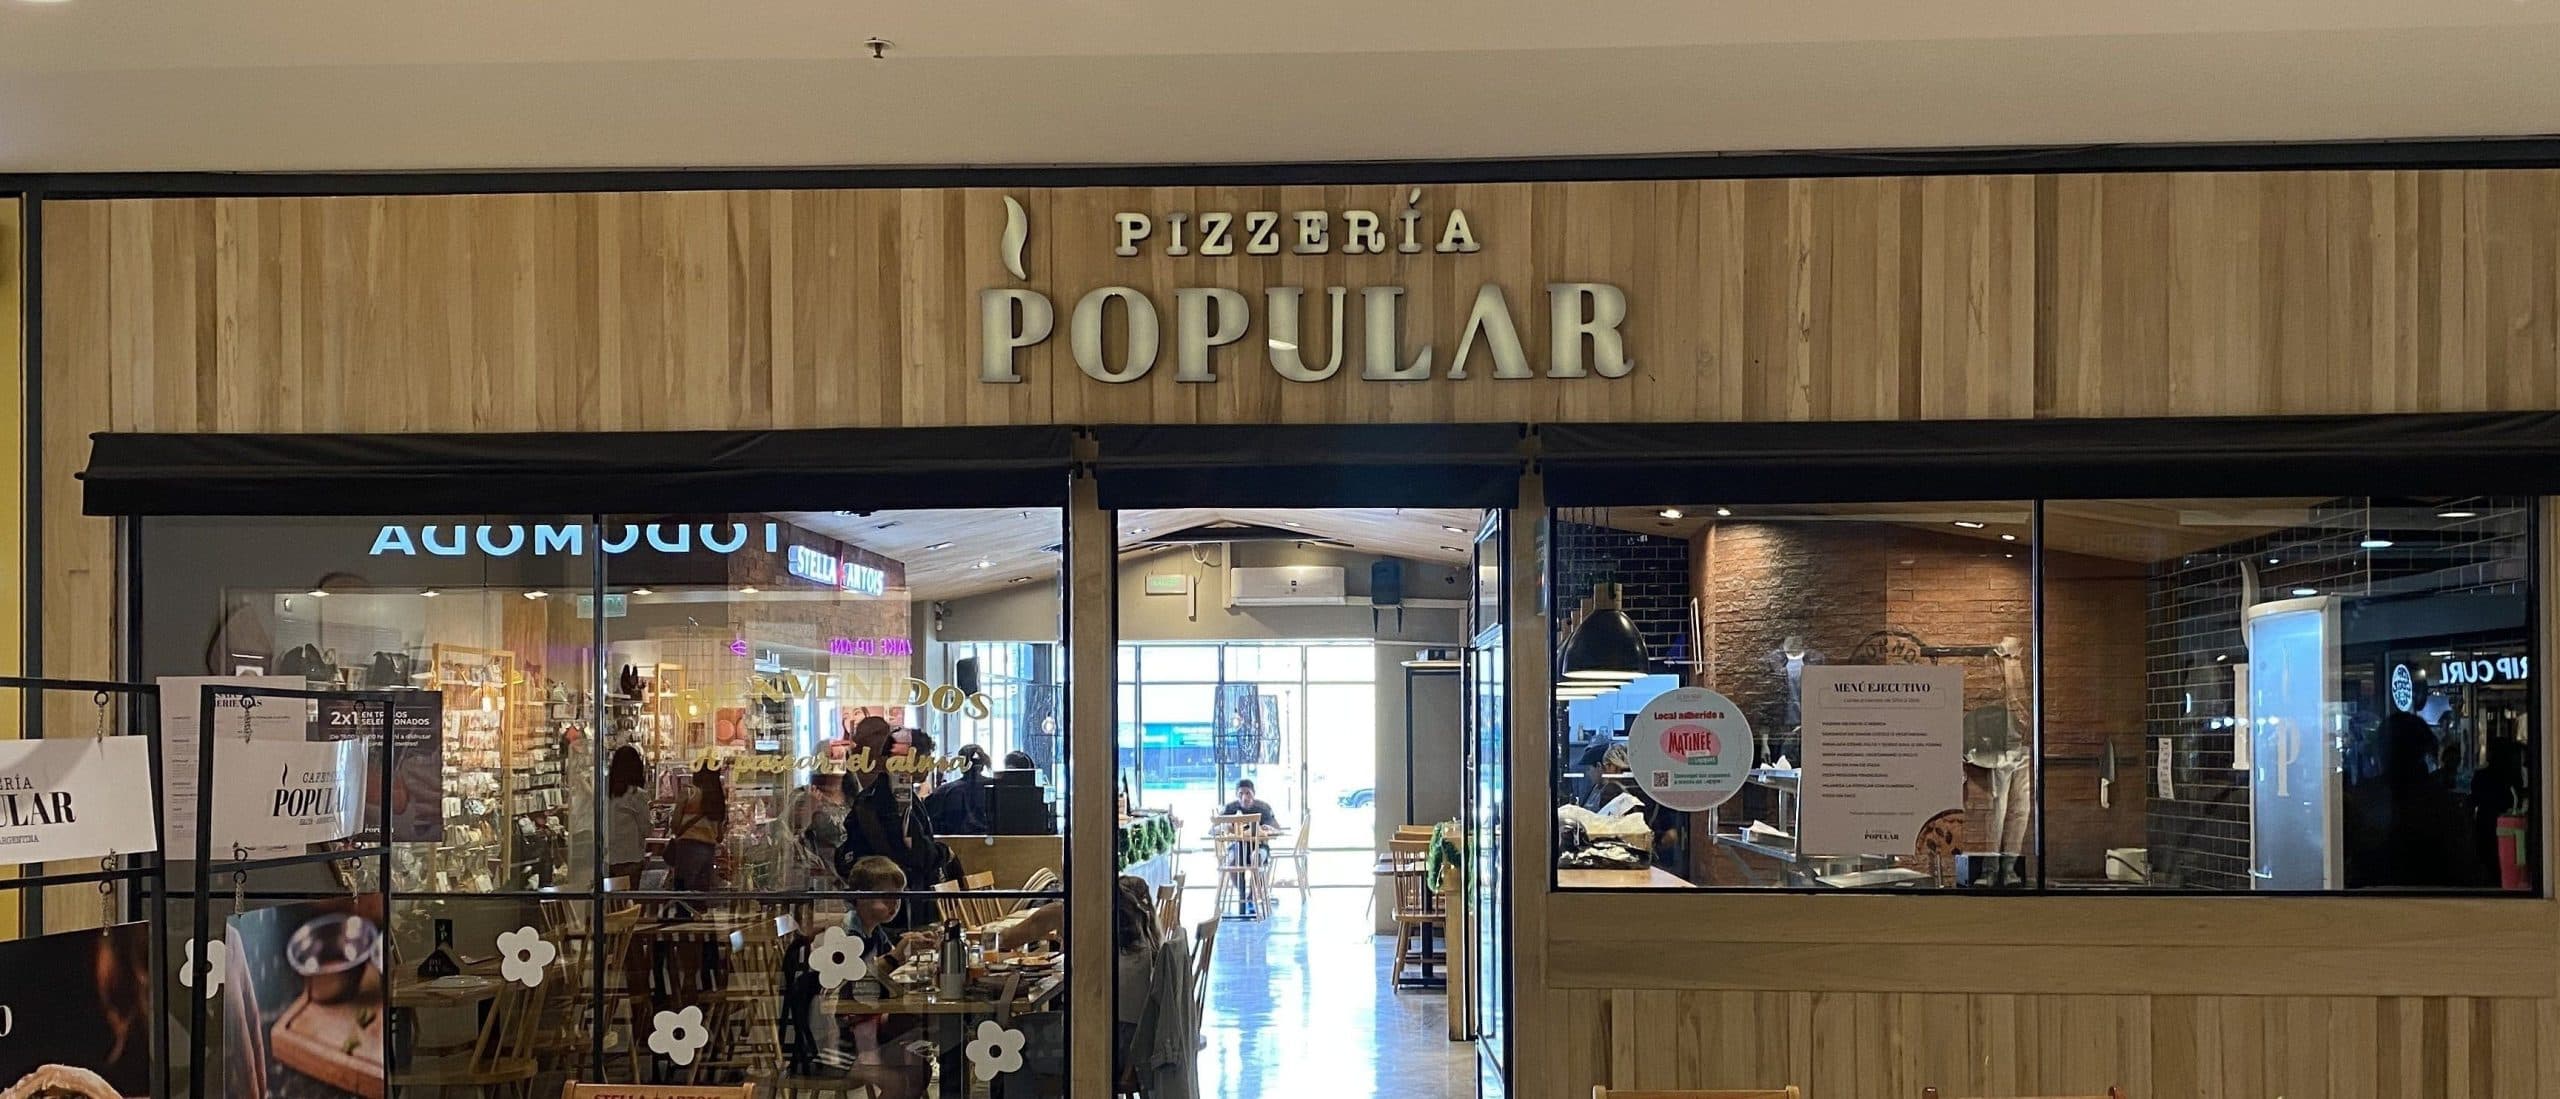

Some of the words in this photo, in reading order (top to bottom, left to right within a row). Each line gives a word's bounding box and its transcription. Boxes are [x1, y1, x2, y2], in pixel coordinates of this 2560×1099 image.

[1114, 187, 1481, 257] PIZZERÍA
[979, 282, 1635, 383] POPULAR
[796, 545, 838, 585] STELLA
[845, 563, 884, 596] ARTOIS
[1834, 681, 1865, 692] MENÚ
[1868, 683, 1931, 692] EJECUTIVO
[330, 711, 358, 725] 2x1
[1654, 711, 1677, 720] Local
[1679, 710, 1717, 720] adherido
[846, 746, 876, 773] el
[885, 746, 973, 774] alma
[273, 787, 352, 817] POPULA
